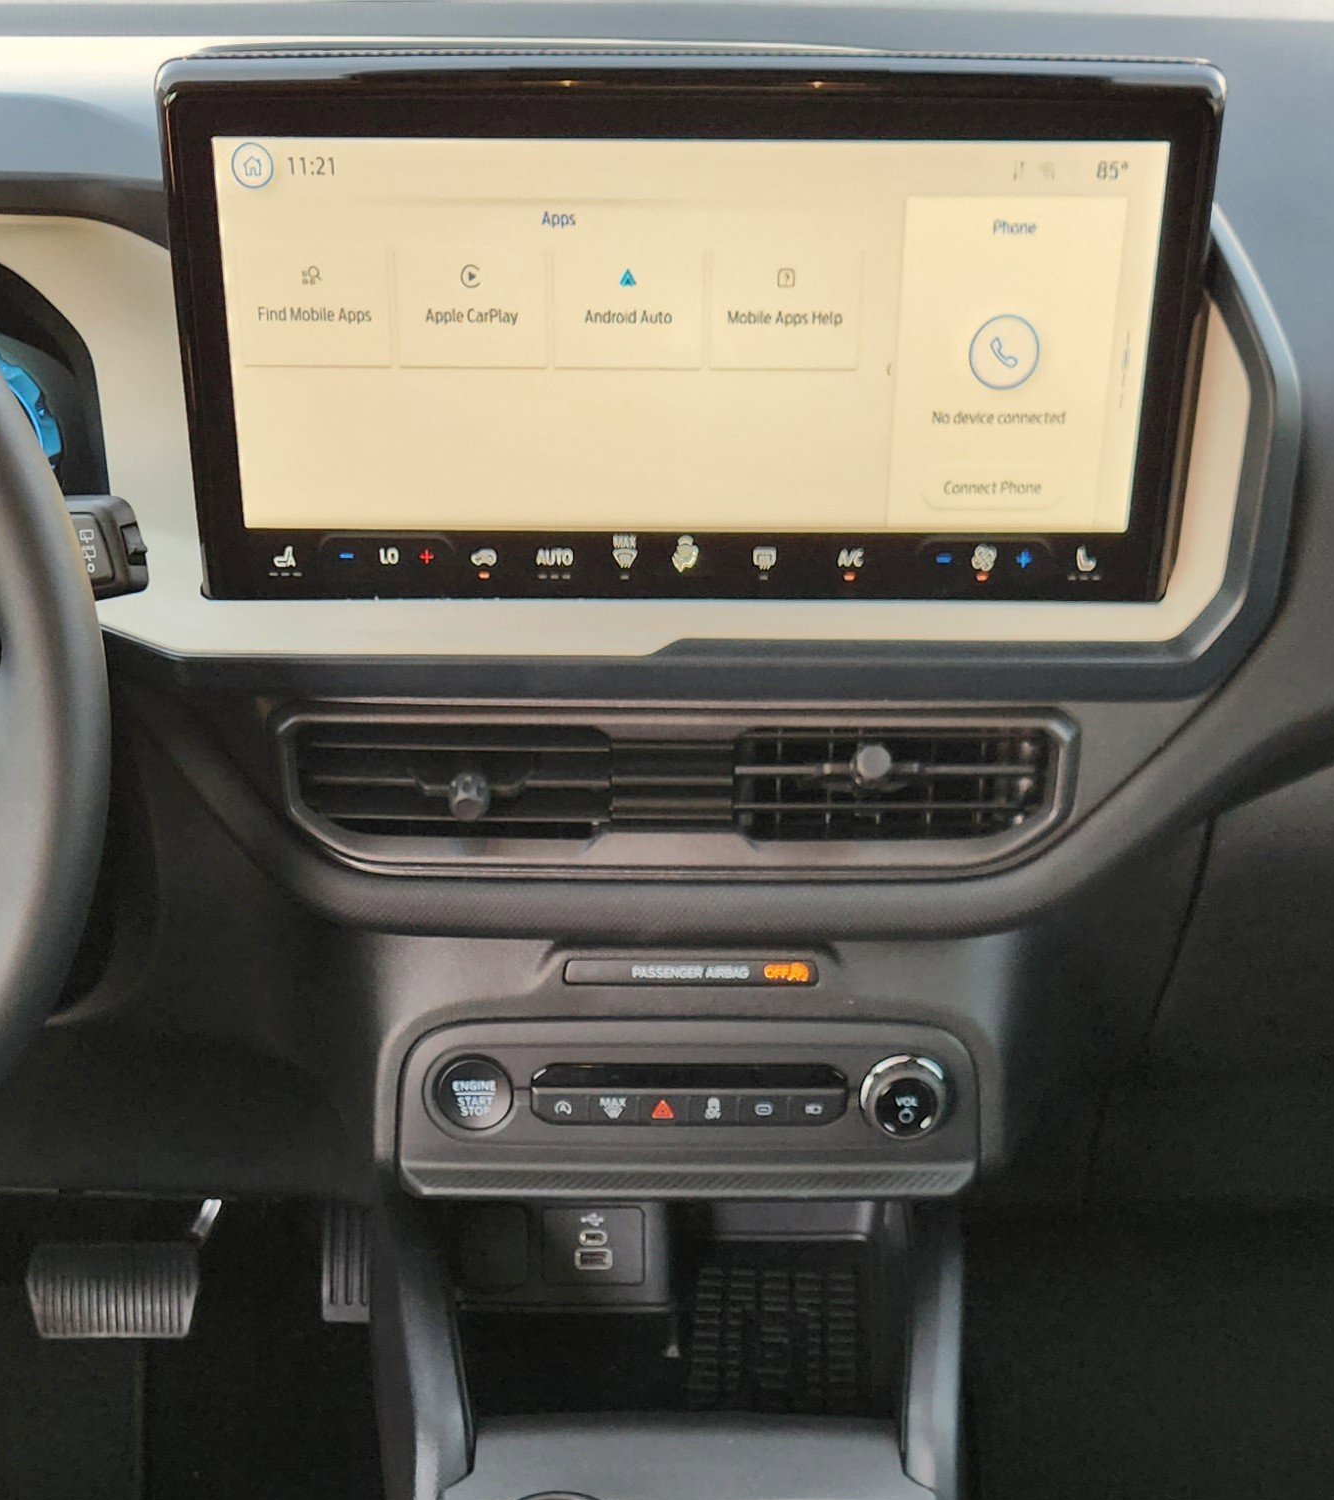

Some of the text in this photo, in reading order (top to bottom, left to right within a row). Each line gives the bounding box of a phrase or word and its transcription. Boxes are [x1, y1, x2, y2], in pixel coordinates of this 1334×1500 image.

[285, 155, 337, 177] 11:21
[541, 210, 577, 229] Apps
[992, 218, 1038, 236] Phone
[257, 306, 373, 325] Find Mobile Apps
[425, 308, 519, 326] Apple CarPlay
[584, 309, 673, 325] Android Auto
[726, 310, 843, 328] Mobile Apps Help
[931, 410, 1067, 426] No device connected
[943, 480, 1042, 496] Connect Phone
[378, 546, 400, 566] LO
[535, 547, 575, 567] AUTO
[631, 963, 704, 979] PASSENGER
[704, 963, 750, 980] AIRBAG
[451, 1079, 497, 1092] ENGINE
[456, 1096, 493, 1108] START
[460, 1106, 491, 1117] STOP
